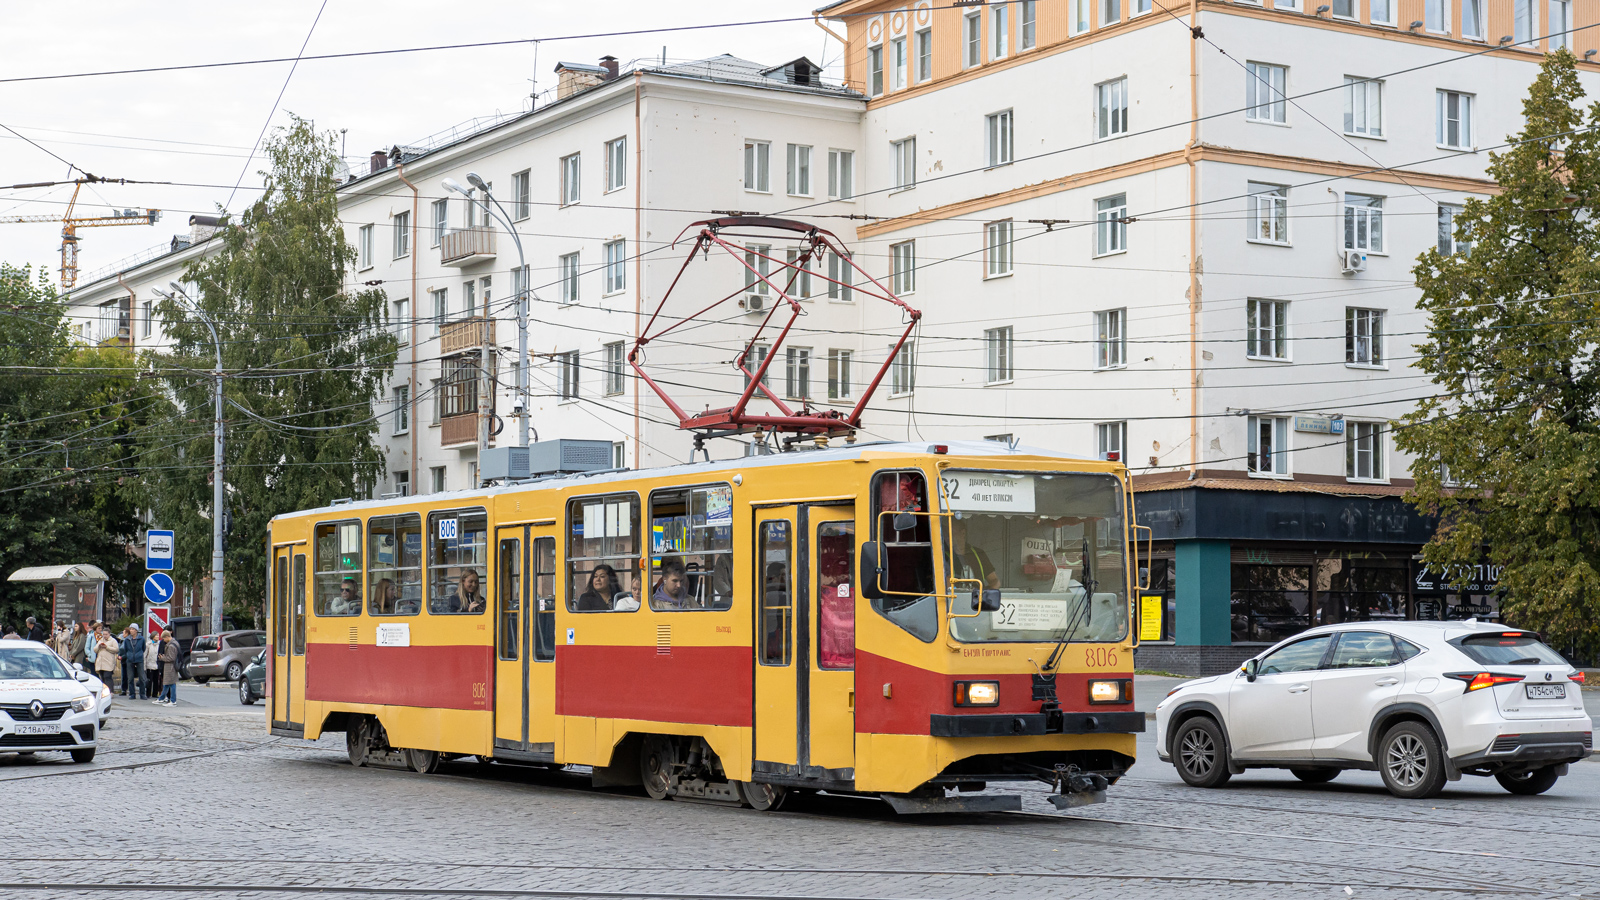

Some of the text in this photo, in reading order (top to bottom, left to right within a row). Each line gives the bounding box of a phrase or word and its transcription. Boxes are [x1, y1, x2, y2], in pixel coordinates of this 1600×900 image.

[1333, 421, 1343, 431] 103
[968, 478, 991, 487] ДВОРЕЦ
[972, 493, 1013, 502] 40 ЛЕТ ВЛКСМ
[441, 520, 455, 538] 806
[998, 603, 1015, 625] 32
[1085, 647, 1117, 667] 806
[472, 682, 486, 699] 806
